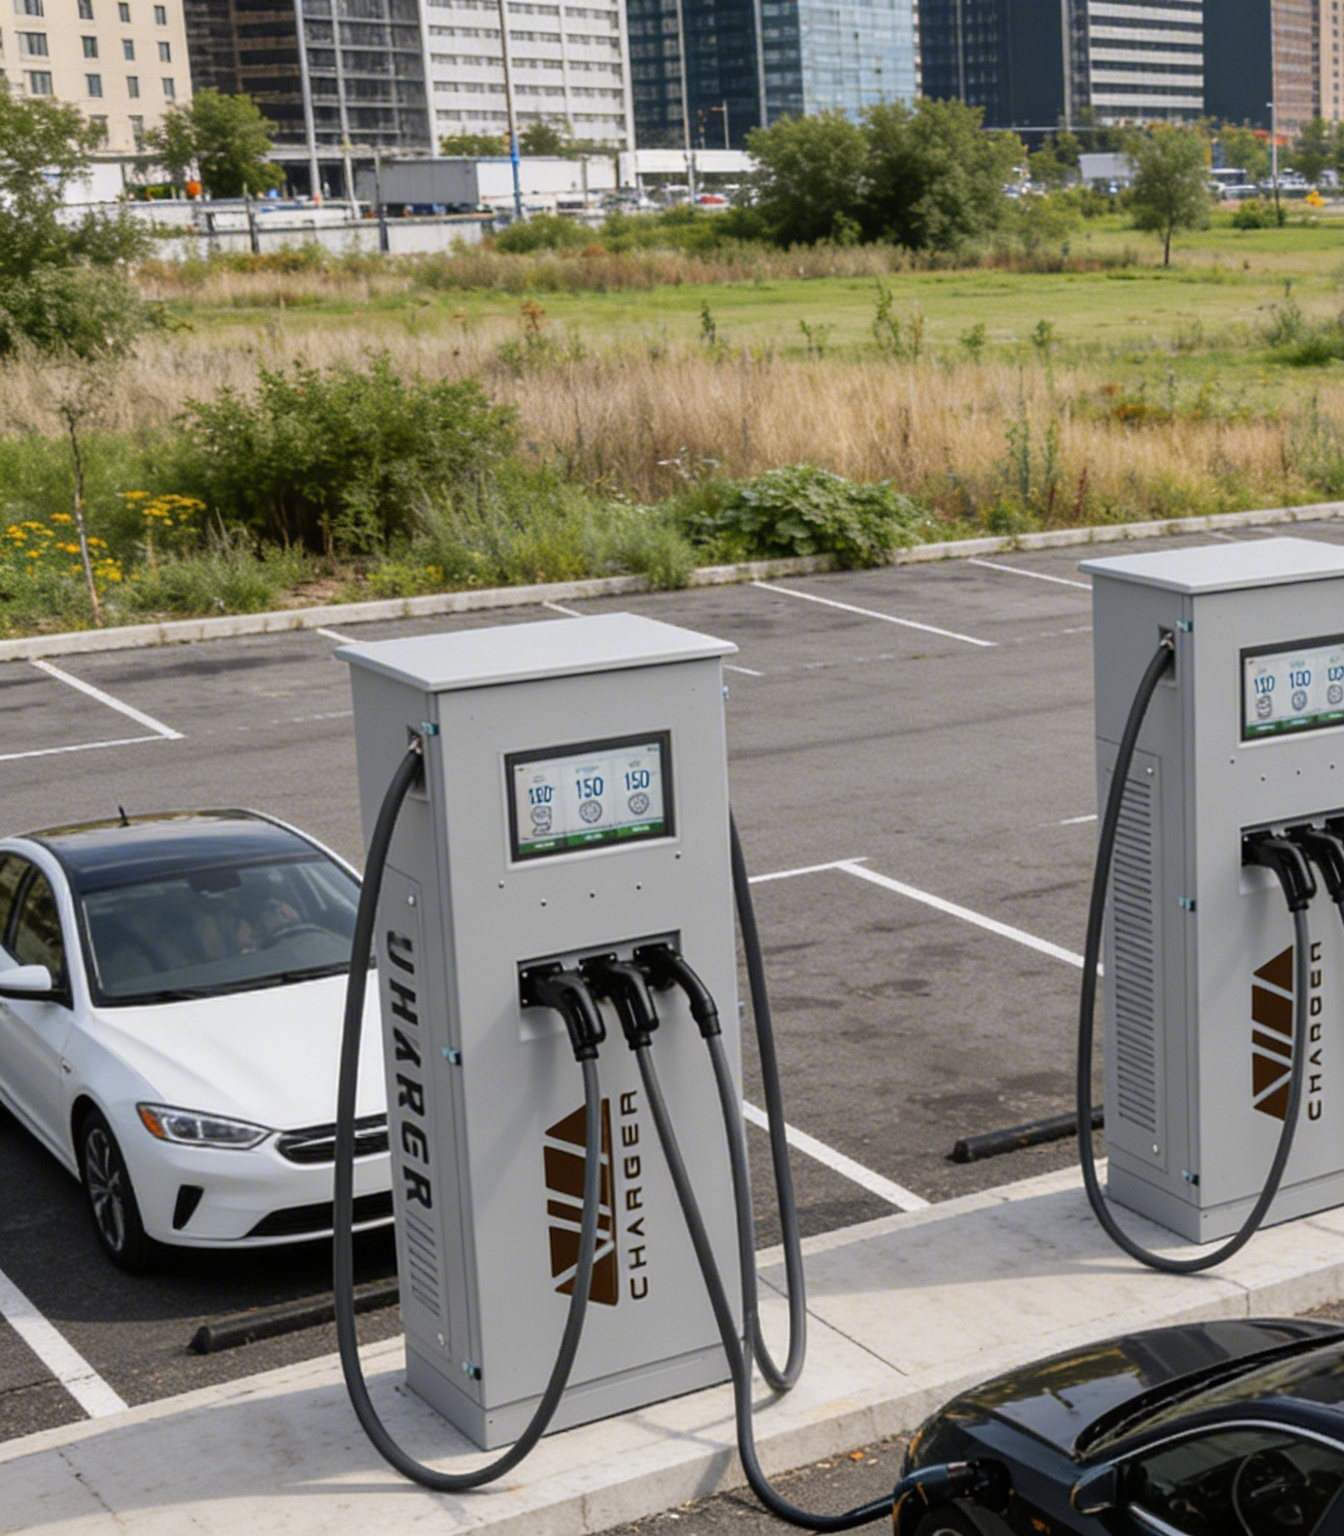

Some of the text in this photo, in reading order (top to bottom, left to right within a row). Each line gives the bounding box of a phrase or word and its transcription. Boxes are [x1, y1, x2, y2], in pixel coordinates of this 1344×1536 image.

[576, 776, 604, 799] 150
[625, 769, 650, 790] 150
[619, 1090, 649, 1300] CHARGER
